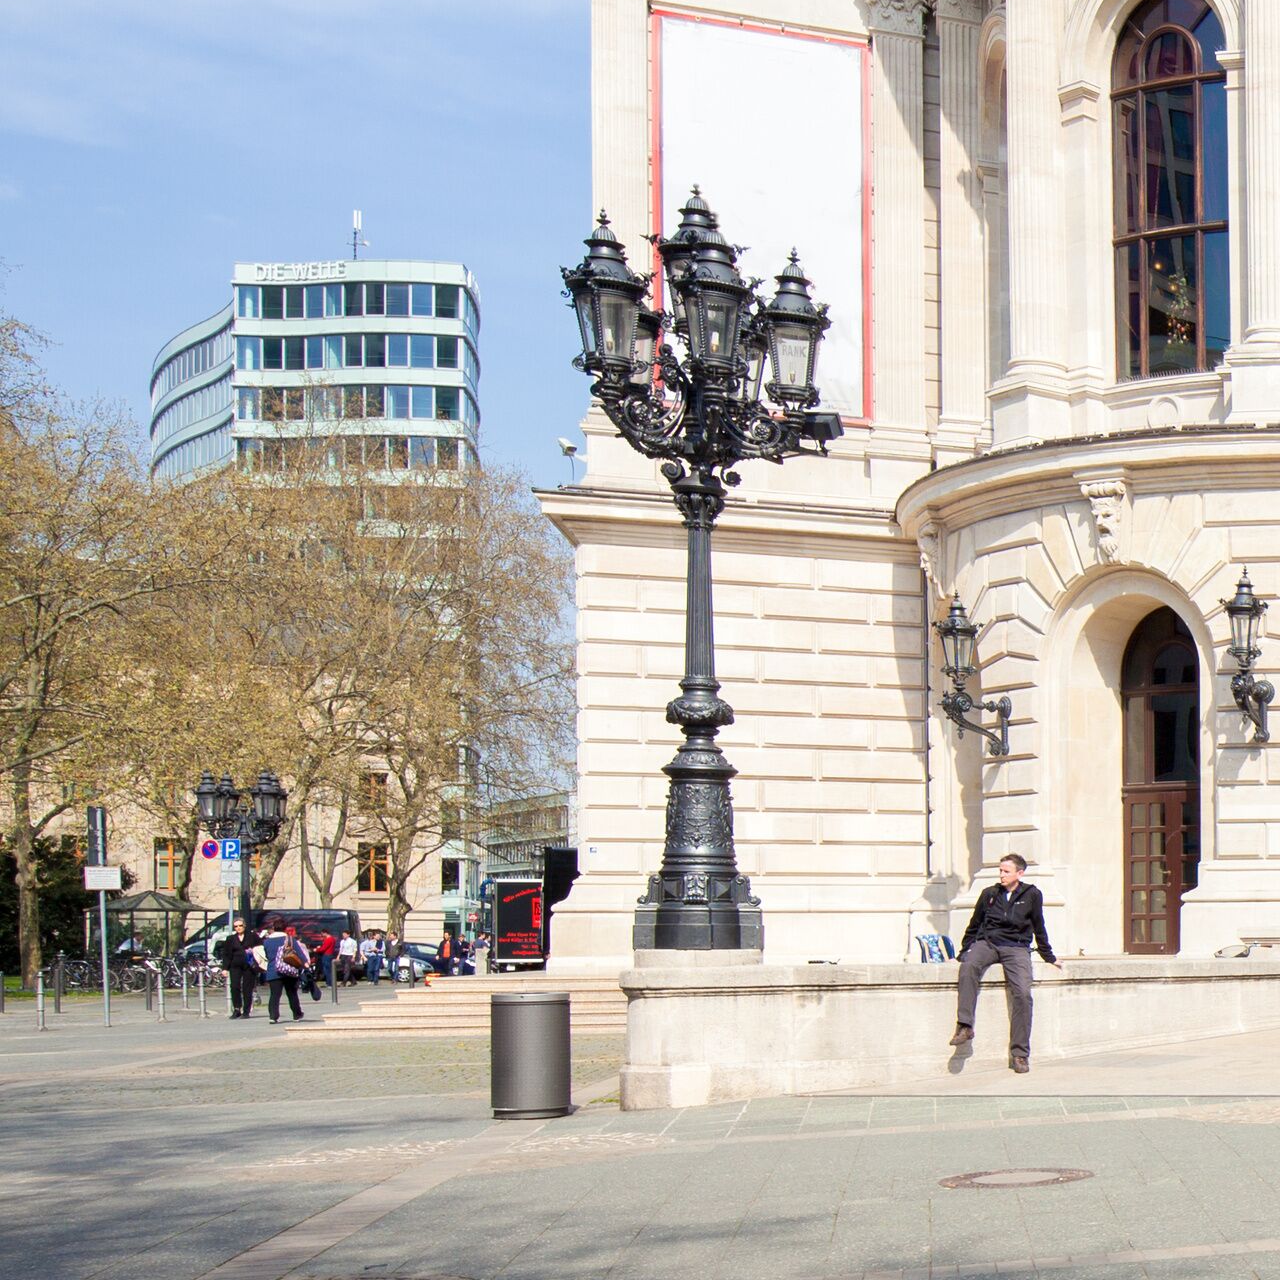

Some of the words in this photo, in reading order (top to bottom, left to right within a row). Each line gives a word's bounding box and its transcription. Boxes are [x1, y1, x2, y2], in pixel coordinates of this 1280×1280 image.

[254, 263, 286, 281] DIE
[291, 261, 347, 281] WELLE
[225, 841, 236, 858] P
